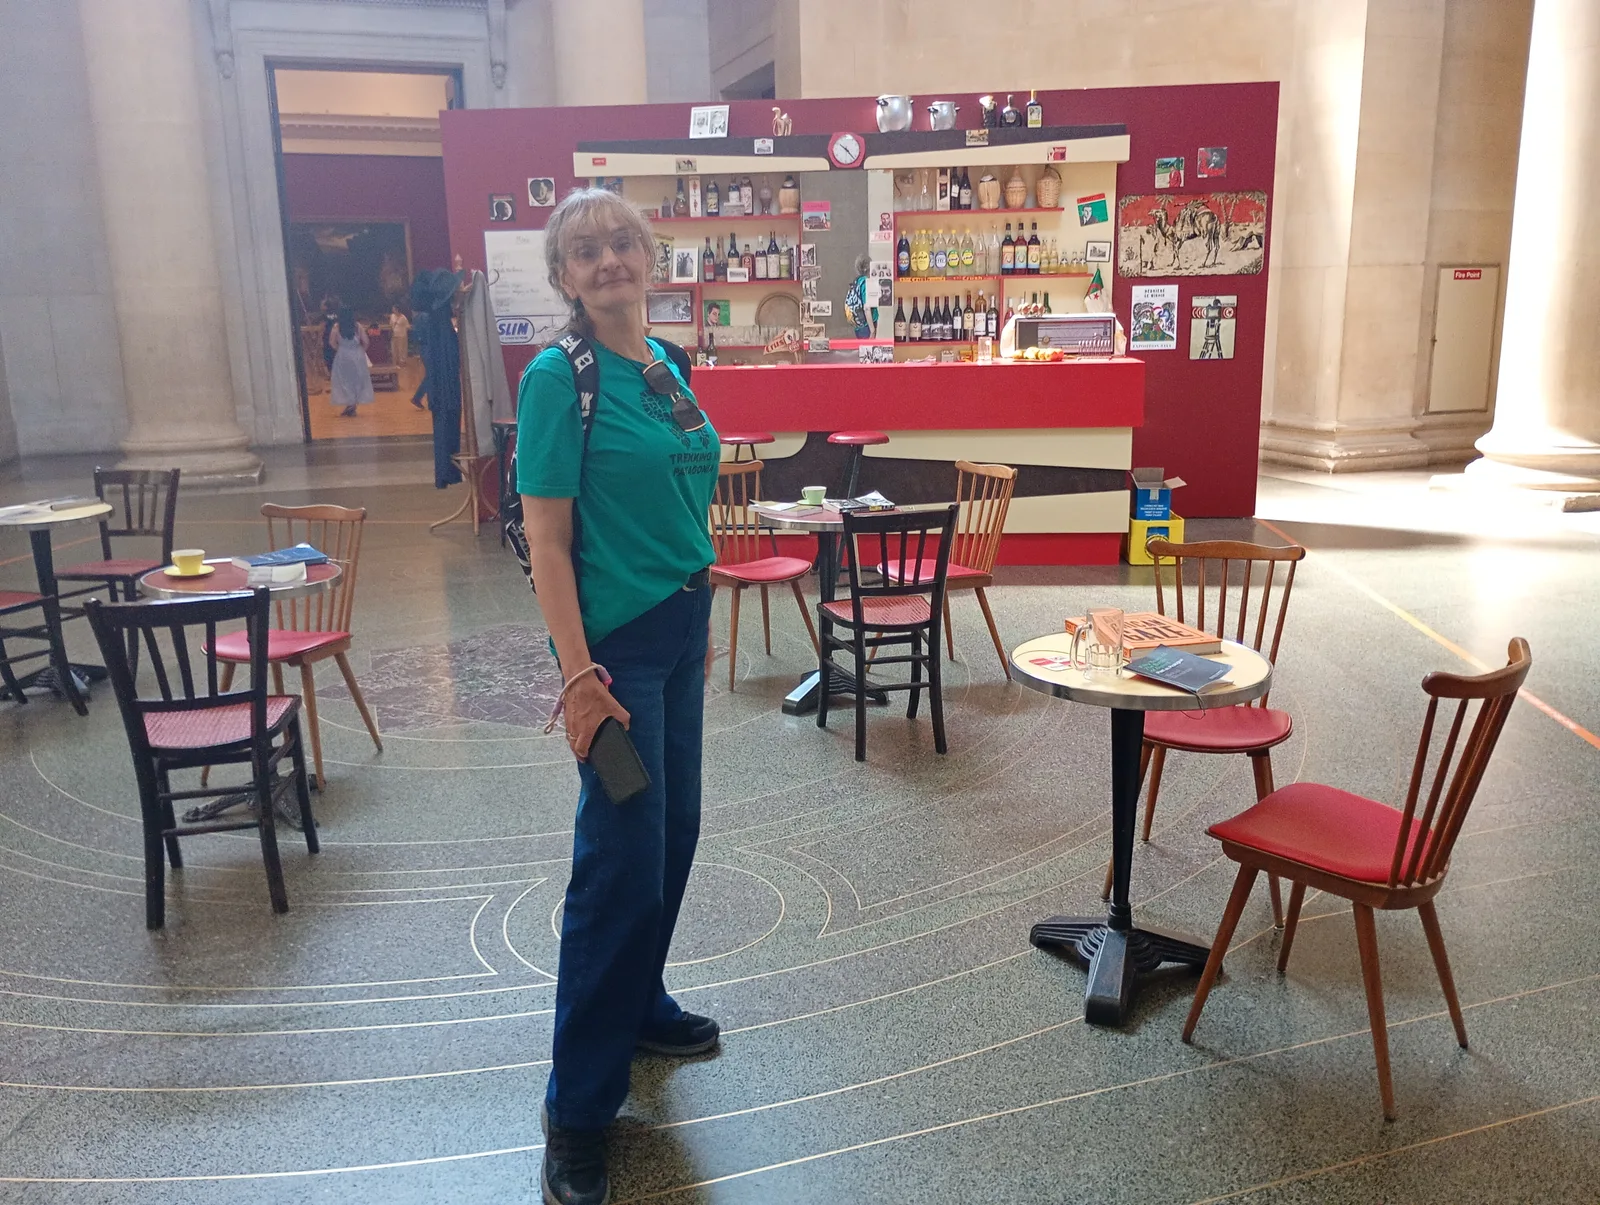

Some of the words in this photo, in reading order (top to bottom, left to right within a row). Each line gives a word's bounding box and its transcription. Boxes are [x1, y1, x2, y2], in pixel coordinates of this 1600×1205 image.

[1455, 271, 1466, 279] Fire
[498, 322, 529, 336] SLIM
[669, 452, 712, 464] TREKKING
[1123, 625, 1194, 641] GAZE
